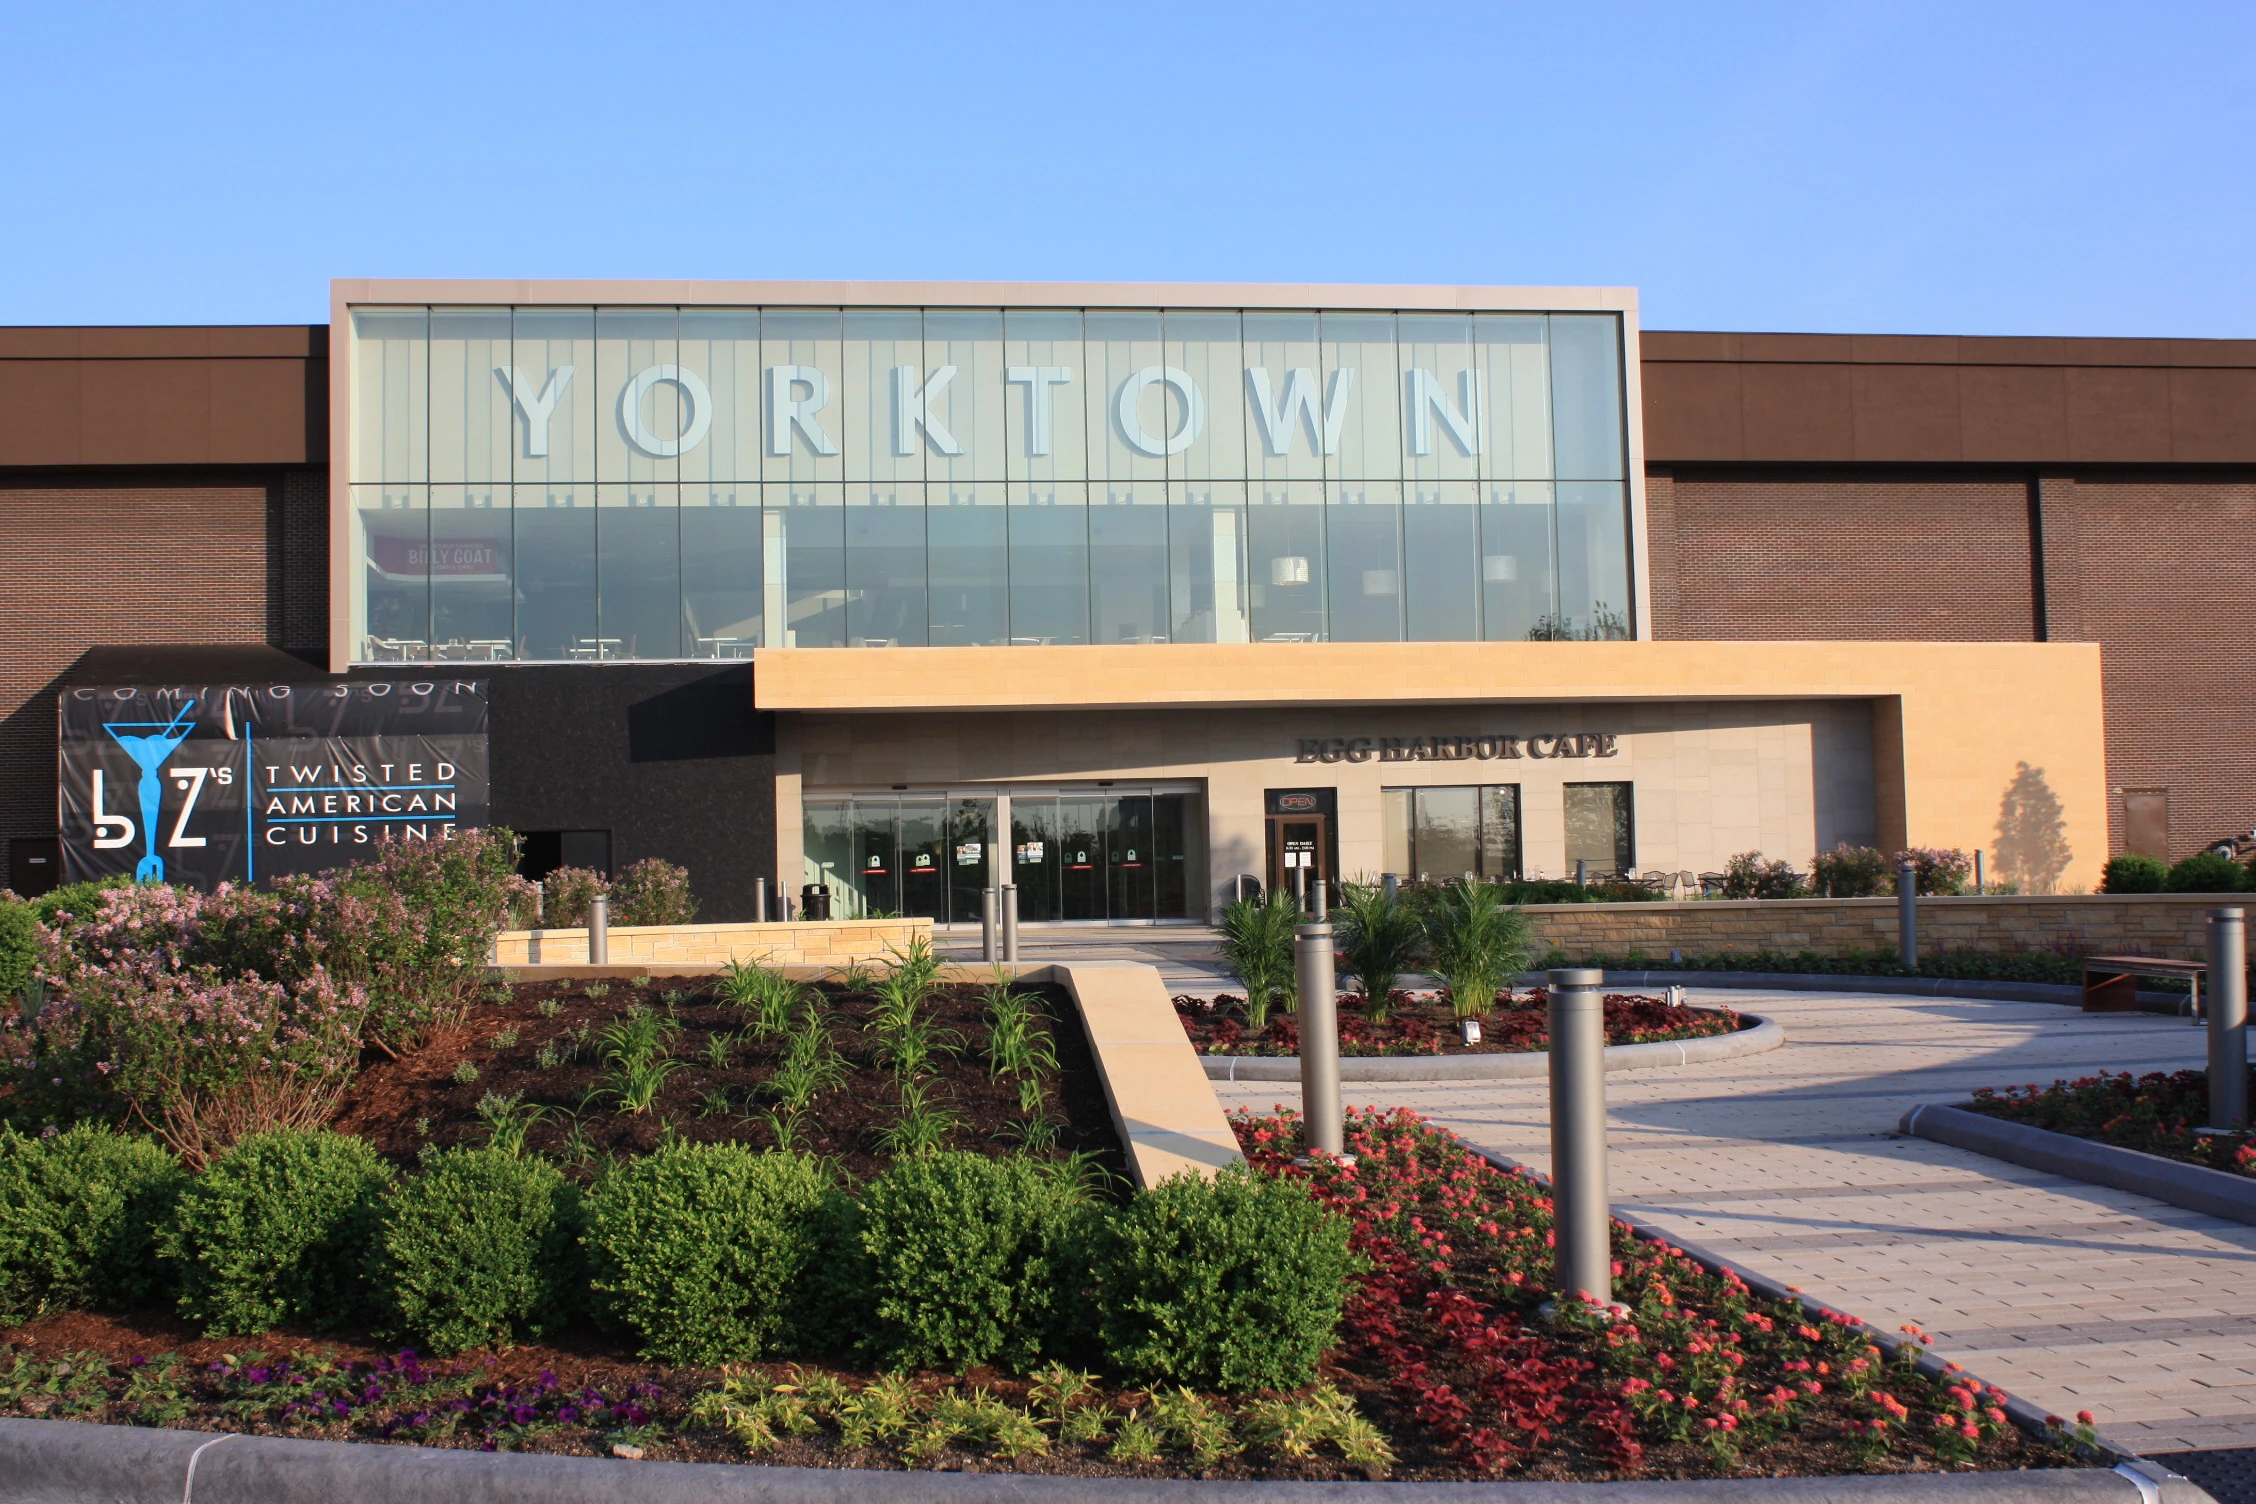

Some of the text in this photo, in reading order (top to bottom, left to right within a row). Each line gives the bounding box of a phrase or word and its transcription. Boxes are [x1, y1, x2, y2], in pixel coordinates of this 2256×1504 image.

[494, 364, 1481, 458] YORKTOWN
[454, 549, 492, 564] GOAT
[74, 682, 477, 700] COMING SOON
[1294, 733, 1618, 763] EGG HARBOR CAFE
[266, 763, 456, 784] TWISTED
[266, 793, 456, 815] AMERICAN
[1283, 798, 1313, 806] OPEN
[266, 823, 456, 845] CUISINE
